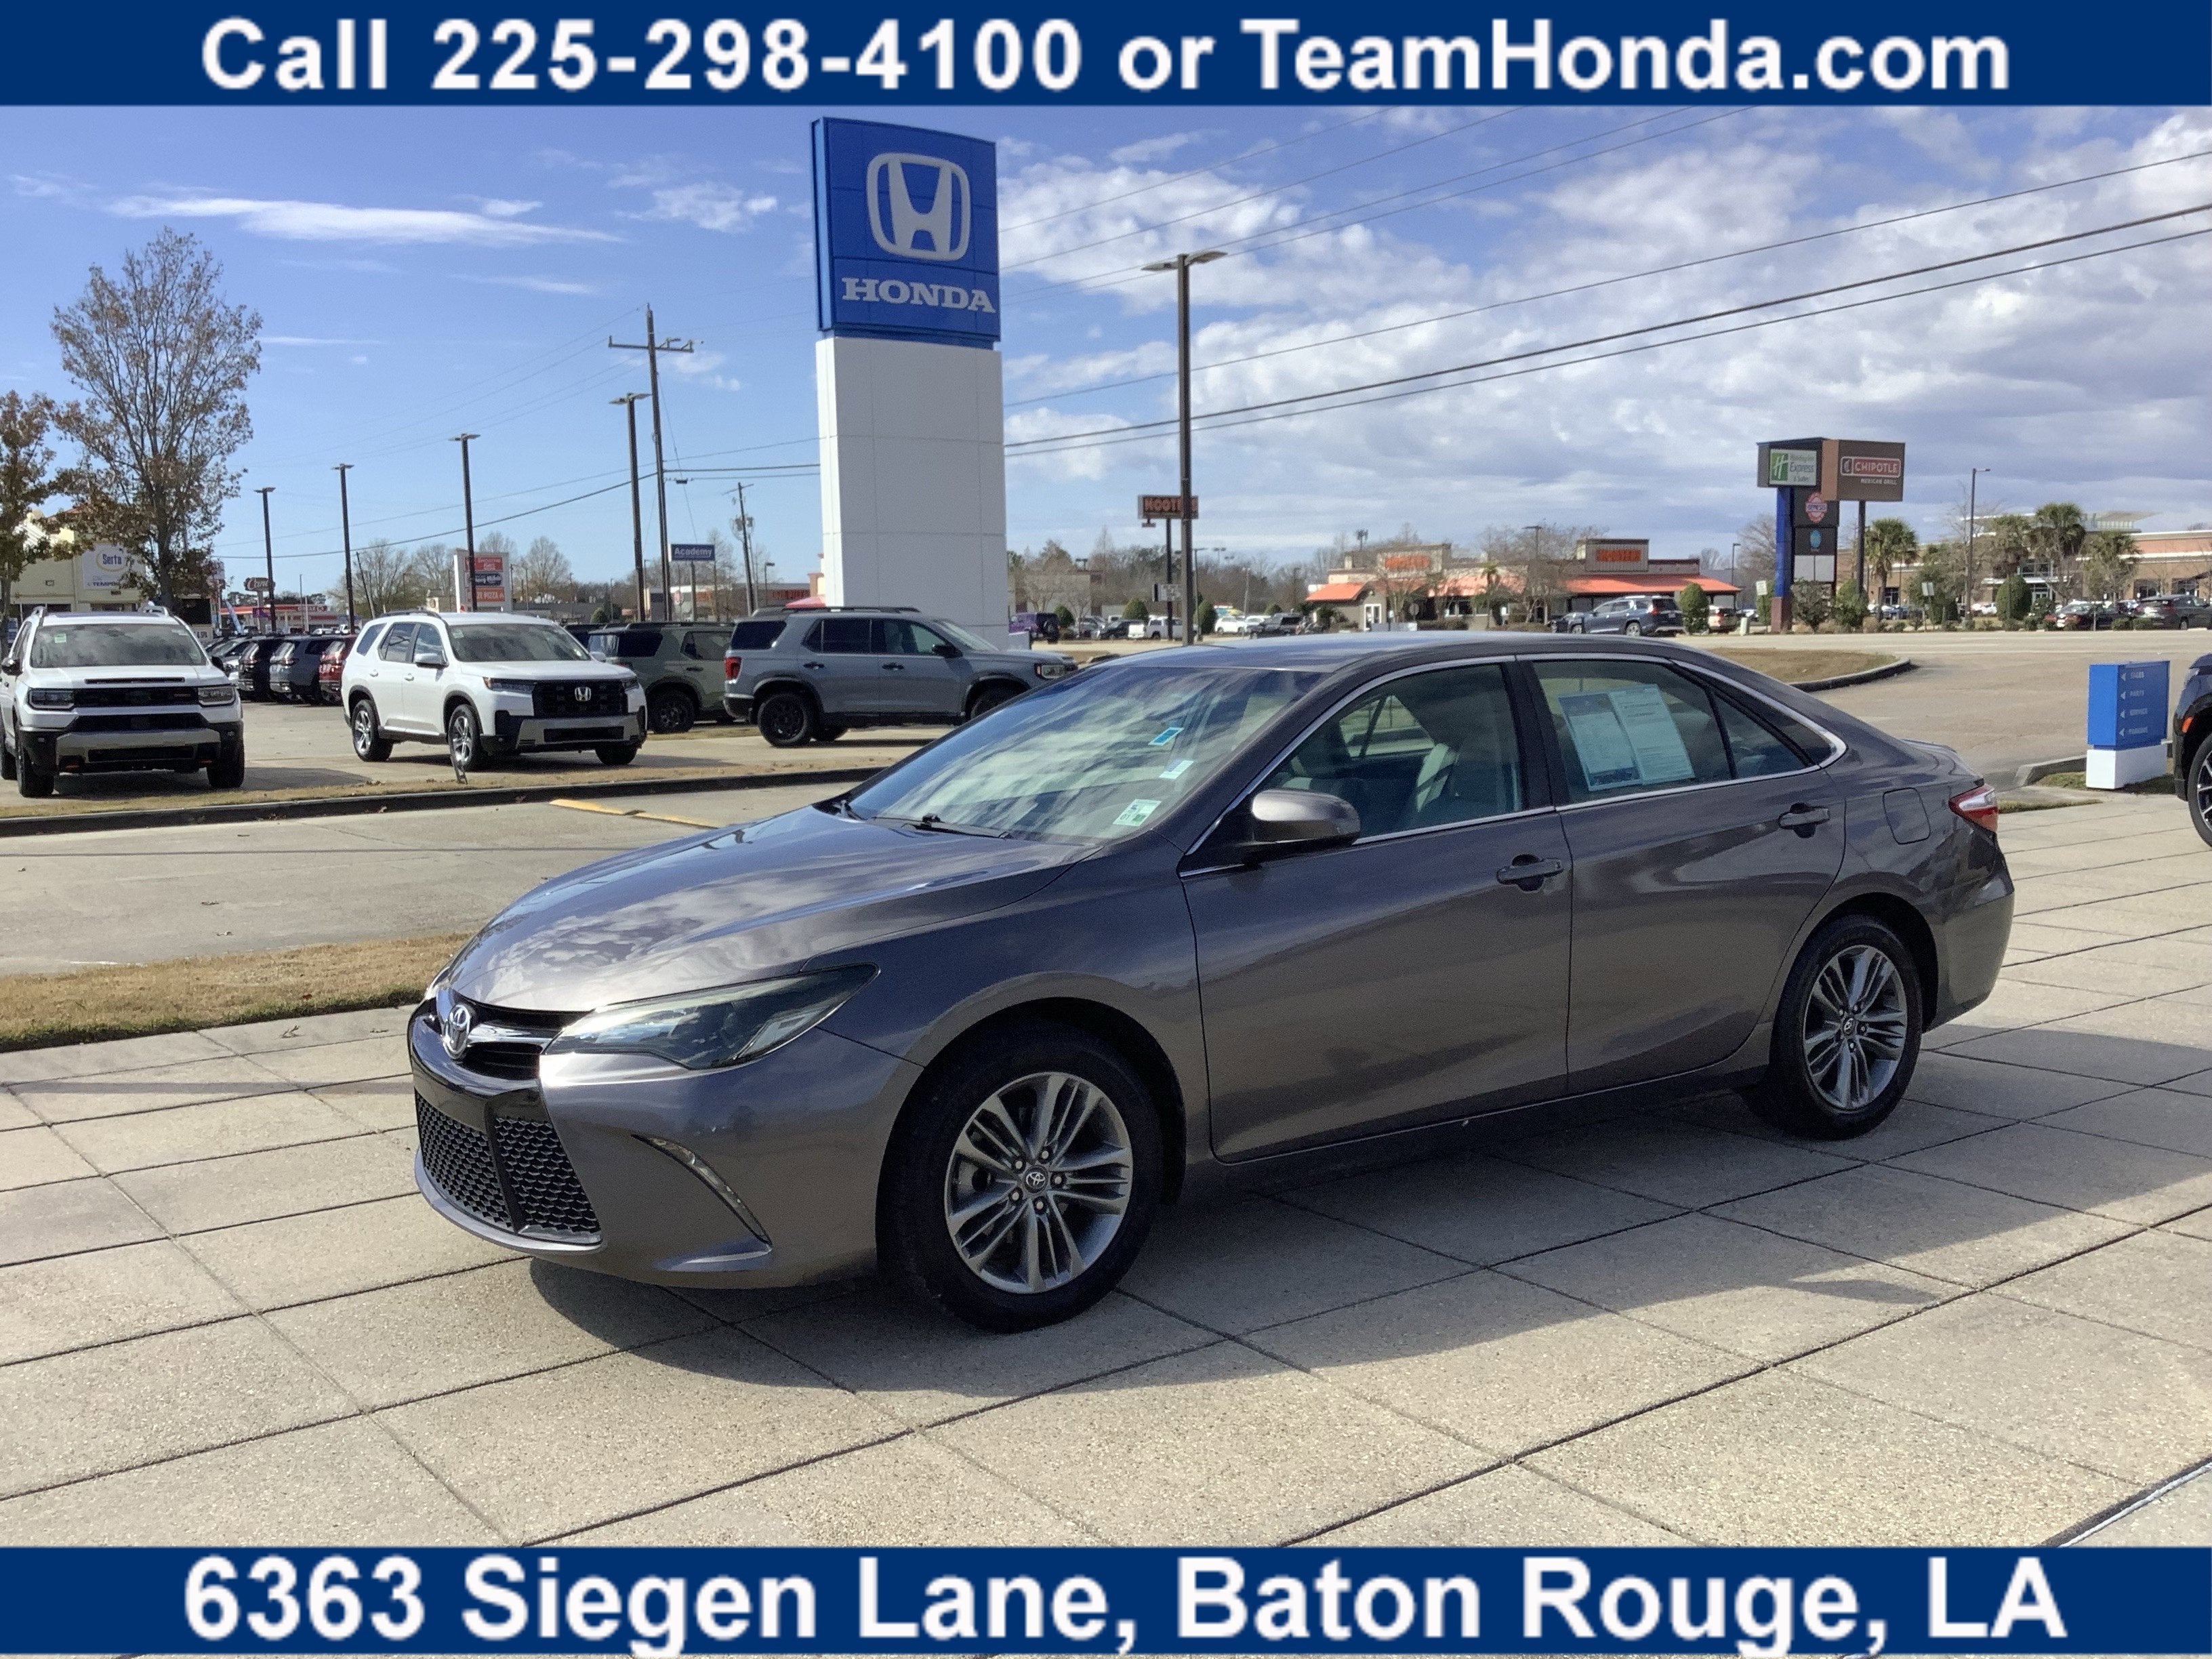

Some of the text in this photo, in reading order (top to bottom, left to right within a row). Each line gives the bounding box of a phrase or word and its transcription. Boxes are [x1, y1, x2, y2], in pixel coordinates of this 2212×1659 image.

[841, 276, 996, 314] HONDA
[1790, 462, 1815, 474] Express
[1855, 462, 1898, 473] CHIPOTLE
[674, 547, 712, 558] Academy
[102, 554, 122, 565] Serta
